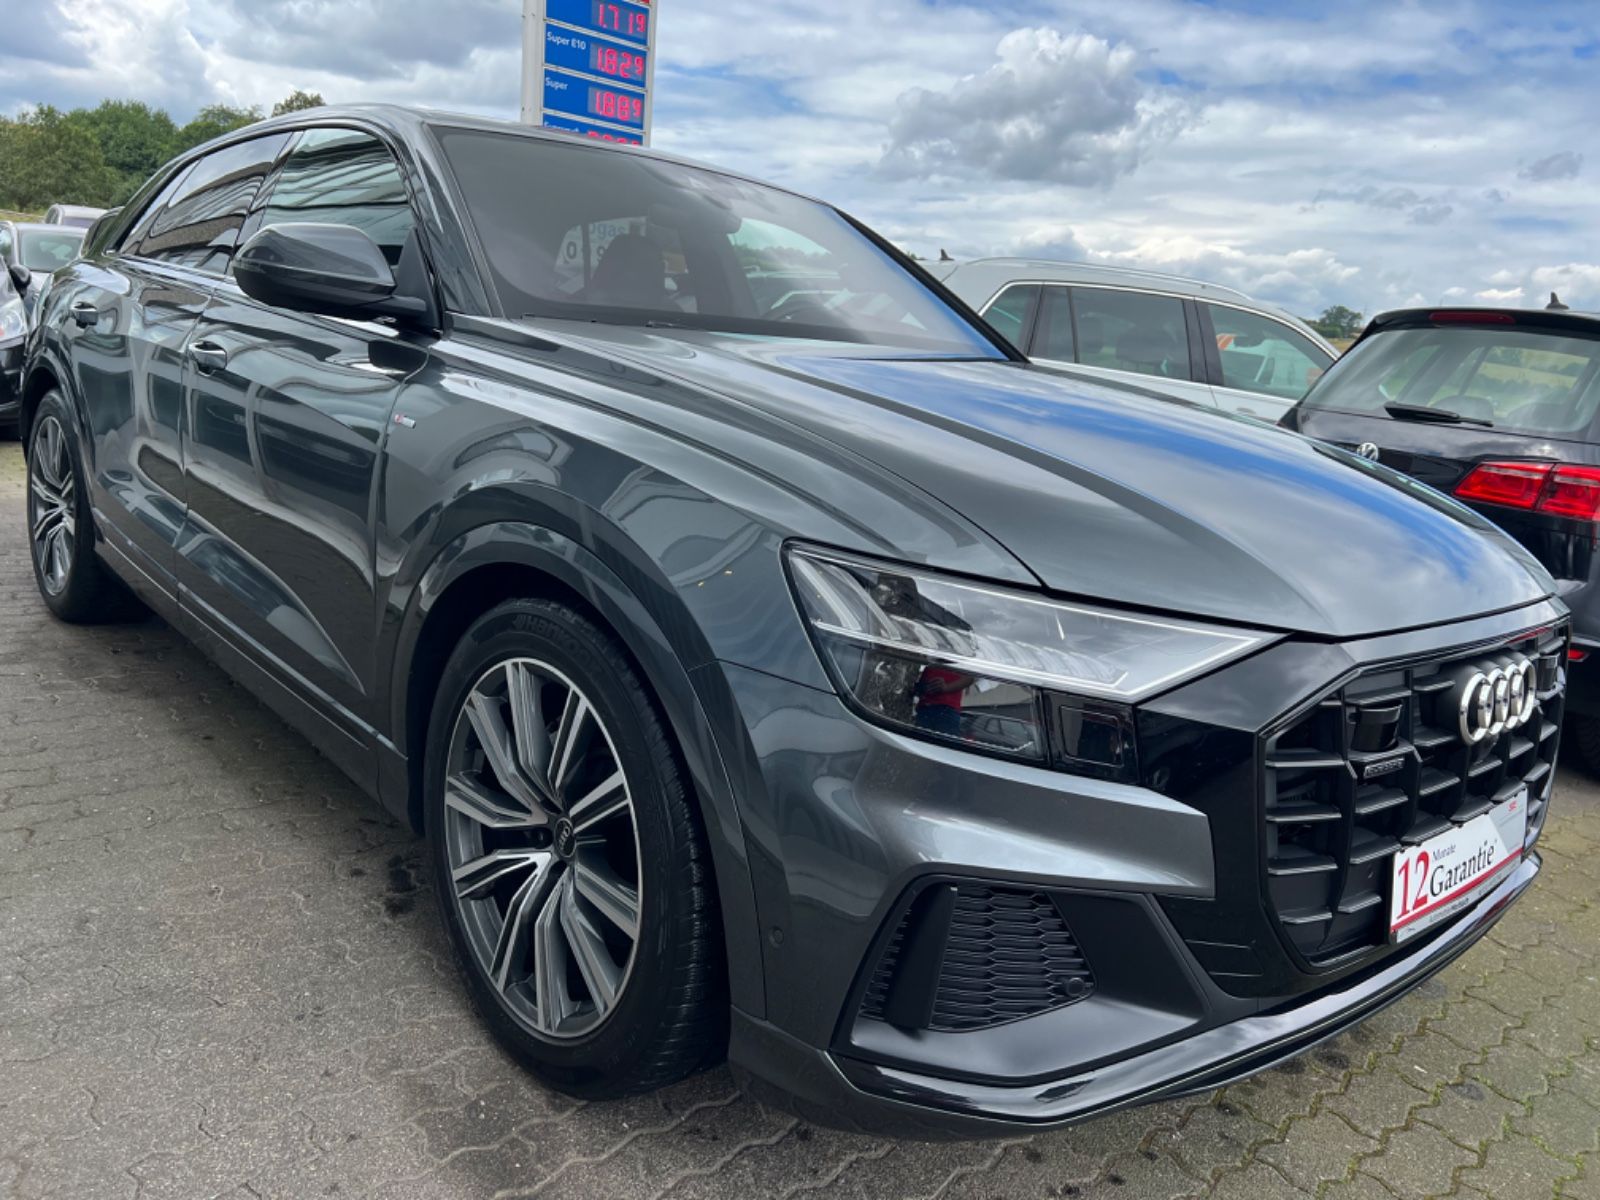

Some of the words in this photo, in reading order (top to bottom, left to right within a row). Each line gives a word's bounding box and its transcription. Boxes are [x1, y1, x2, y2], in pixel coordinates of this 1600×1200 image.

[598, 3, 647, 35] 1.719
[547, 31, 570, 46] Super
[571, 37, 587, 50] E10
[597, 46, 645, 79] 1.829
[545, 77, 568, 91] Super
[595, 90, 642, 122] 1.889
[1396, 849, 1431, 920] 12
